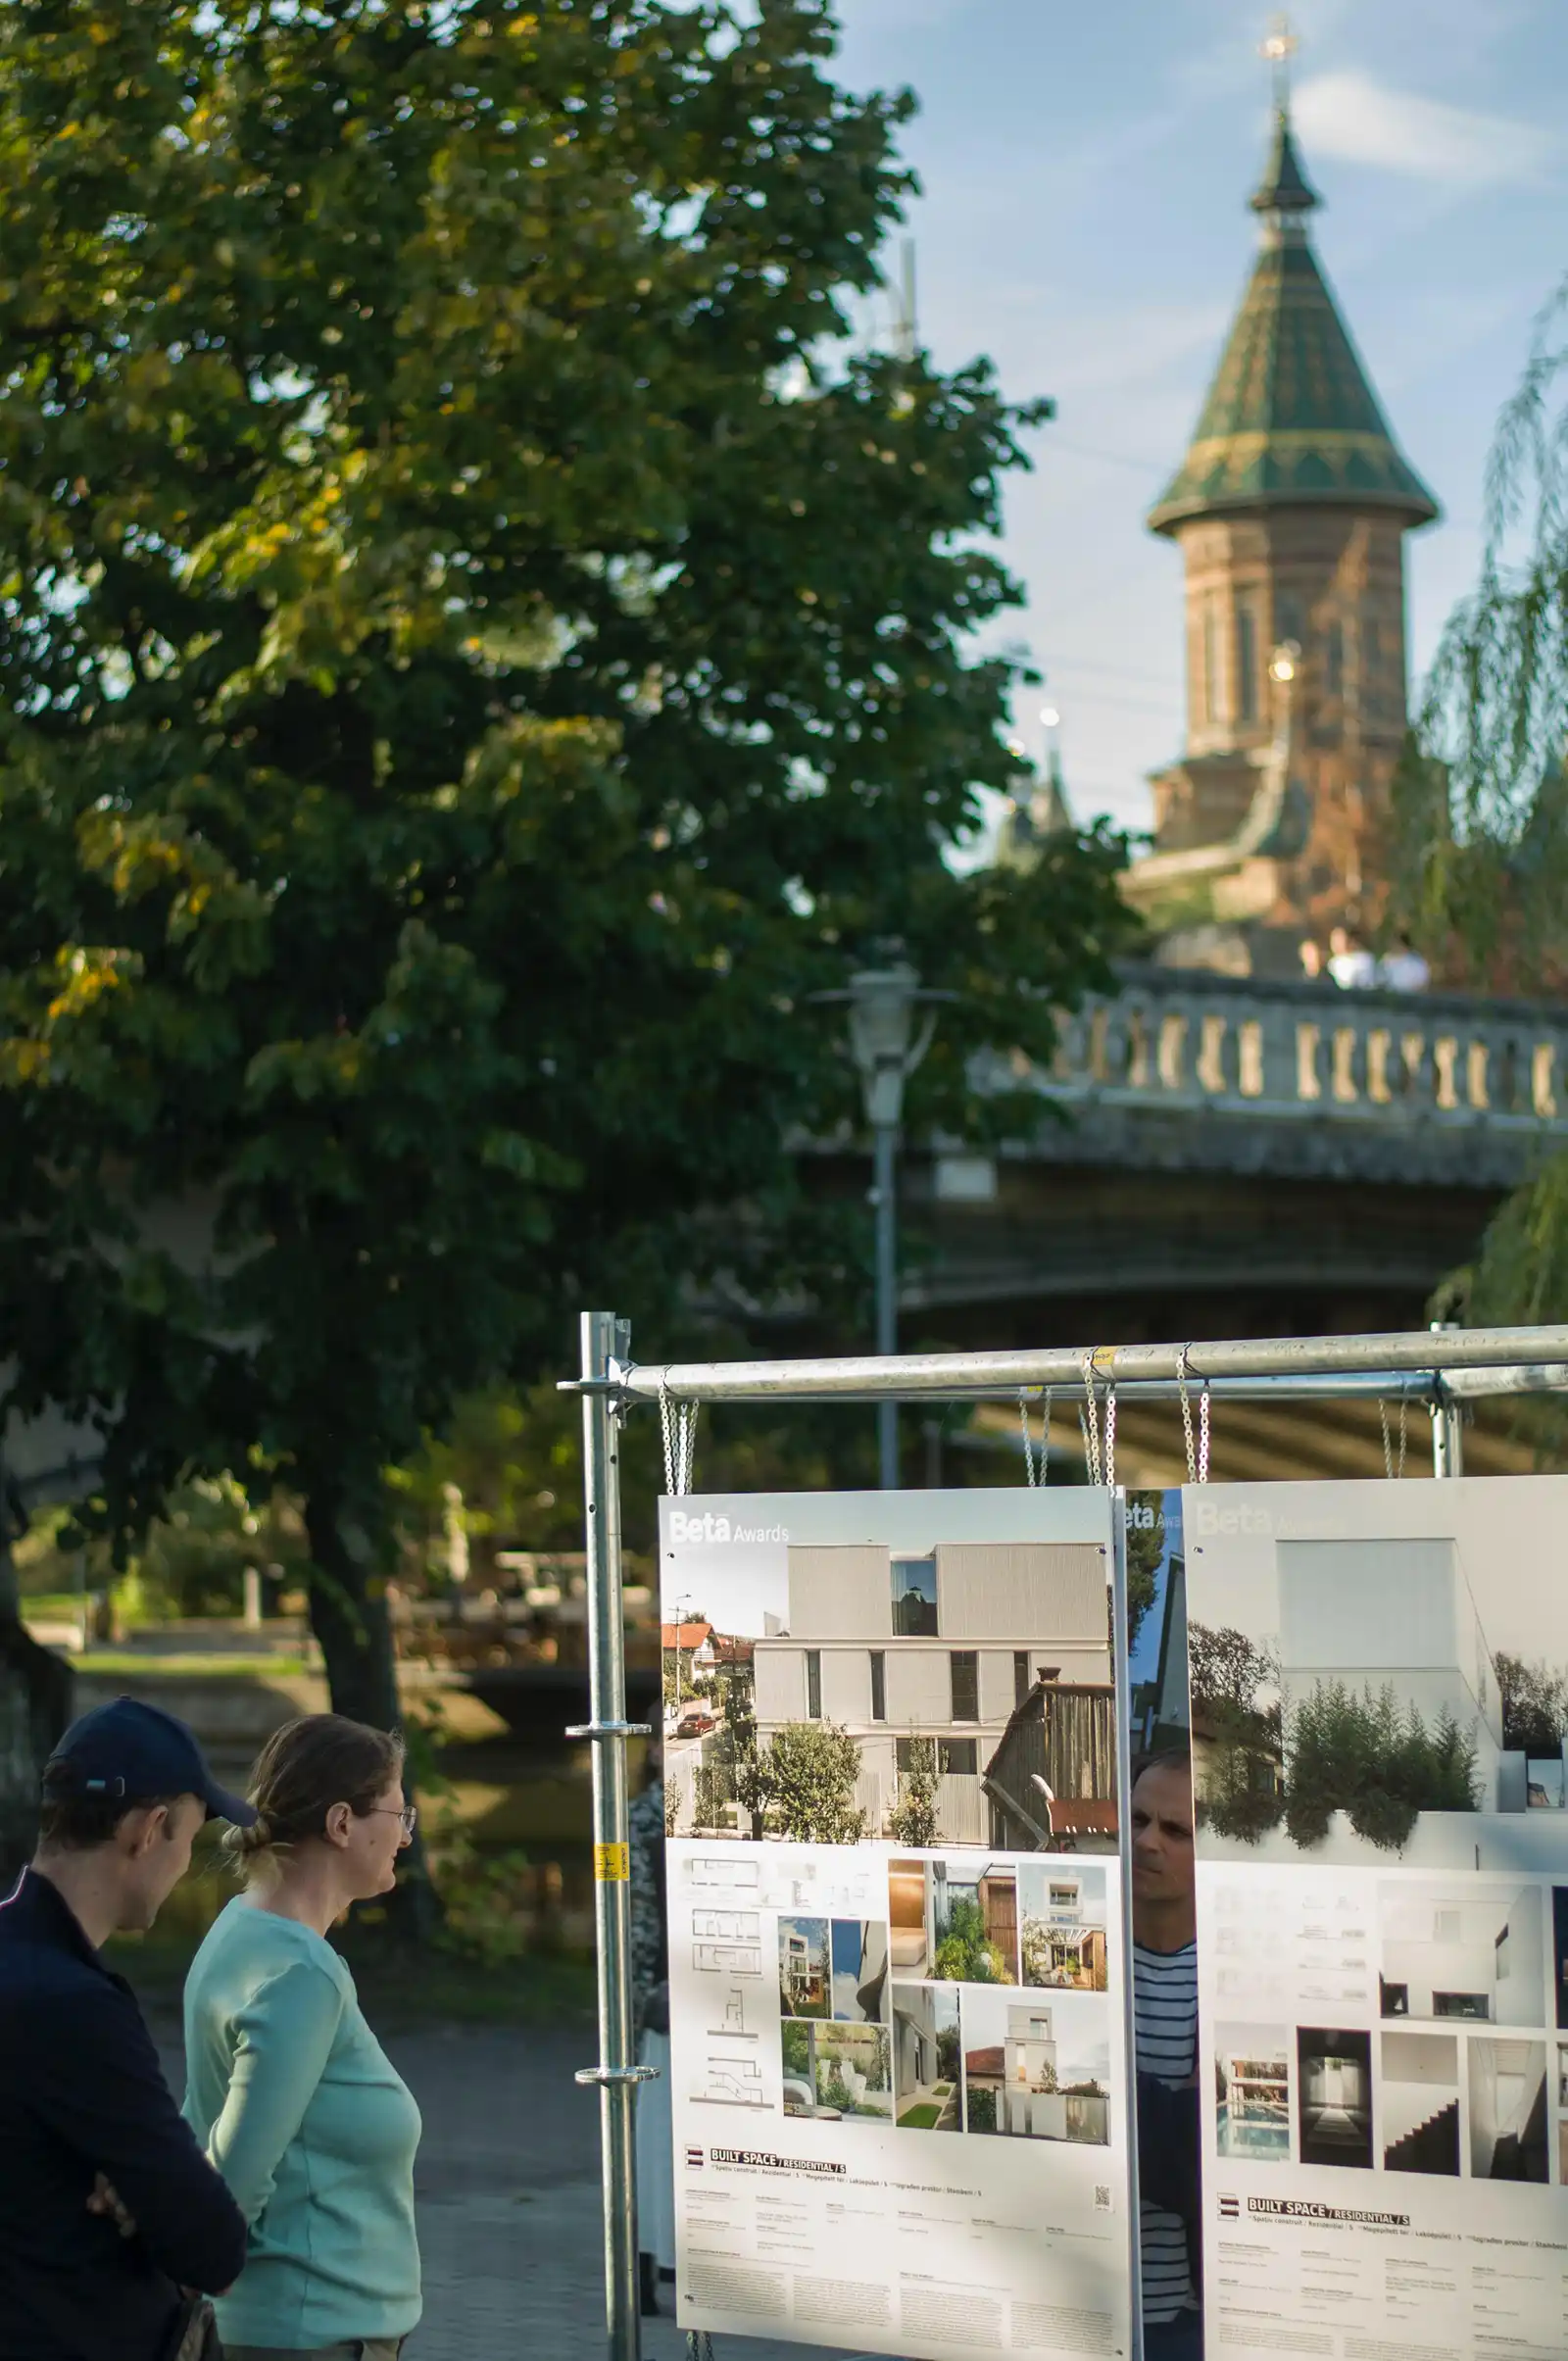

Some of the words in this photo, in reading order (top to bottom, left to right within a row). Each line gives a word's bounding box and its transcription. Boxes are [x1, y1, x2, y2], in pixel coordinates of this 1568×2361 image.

[733, 1524, 789, 1543] Awards
[711, 2149, 741, 2163] BUILT
[743, 2152, 777, 2166] SPACE
[784, 2159, 833, 2173] RESIDENTIAL
[840, 2164, 846, 2173] S
[1249, 2198, 1284, 2213] BUILT
[1287, 2202, 1325, 2217] SPACE
[1335, 2209, 1395, 2225] RESIDENTIAL
[1402, 2215, 1409, 2225] S
